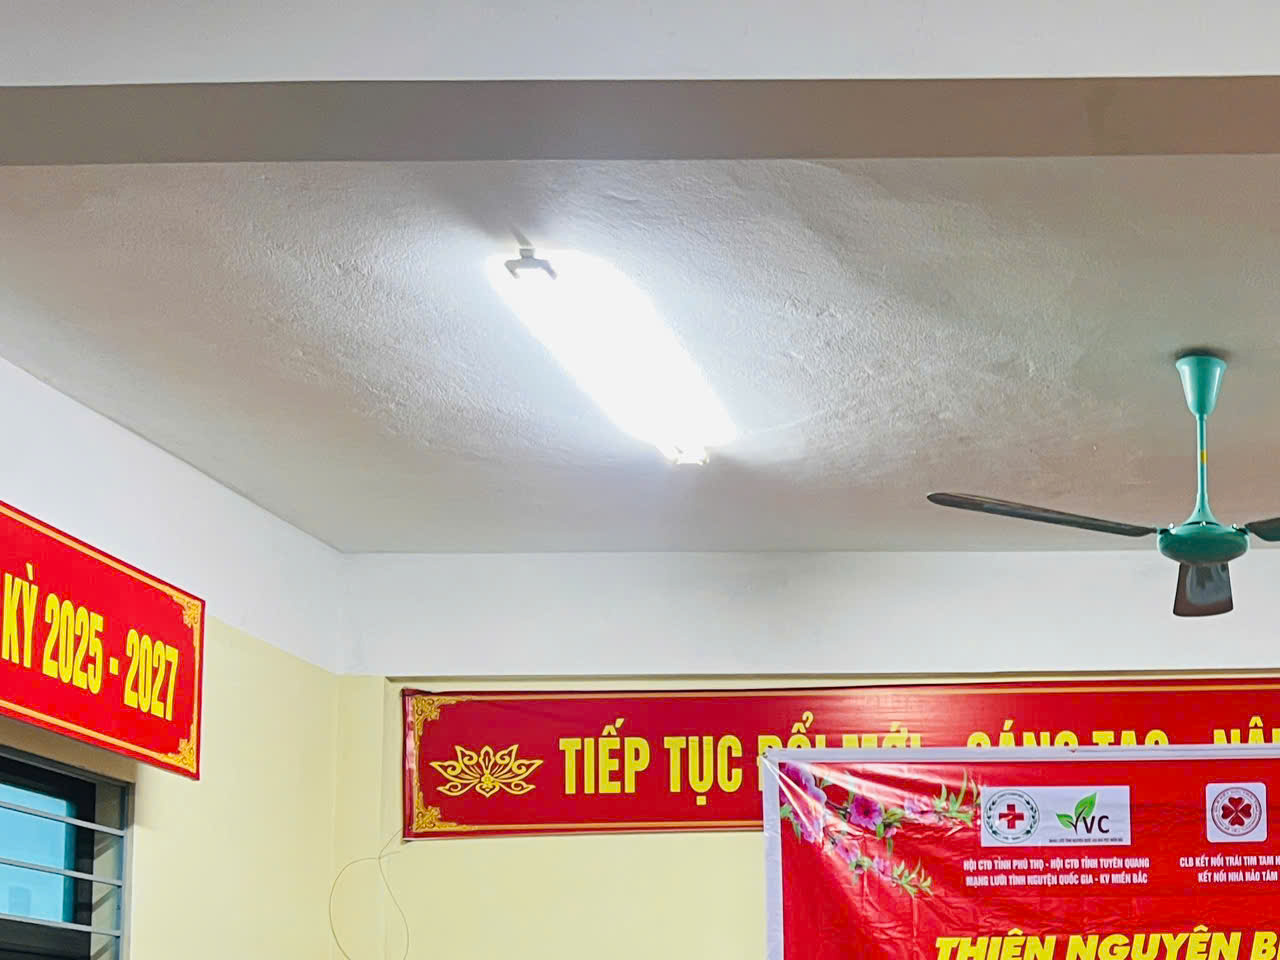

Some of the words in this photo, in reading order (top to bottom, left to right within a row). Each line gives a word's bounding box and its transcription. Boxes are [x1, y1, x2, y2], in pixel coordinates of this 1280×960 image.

[2, 563, 39, 668] KỲ
[42, 593, 103, 694] 2025
[124, 629, 179, 721] 2027
[558, 717, 651, 795] TIẾP
[664, 734, 743, 806] TỤC
[963, 857, 977, 872] HỘI
[1012, 857, 1028, 870] PHÚ
[1029, 859, 1044, 872] THỌ
[1050, 857, 1063, 871] HỘI
[1099, 856, 1123, 869] TUYÊN
[1124, 857, 1150, 869] QUANG
[1179, 856, 1194, 867] CLB
[1195, 853, 1209, 867] KẾT
[1210, 852, 1224, 867] NỐI
[1225, 854, 1242, 867] TRÁI
[1243, 855, 1257, 866] TIM
[1080, 874, 1094, 885] GIA
[1198, 869, 1212, 883] KẾT
[1213, 868, 1227, 882] NỐI
[1262, 869, 1278, 881] TÂM
